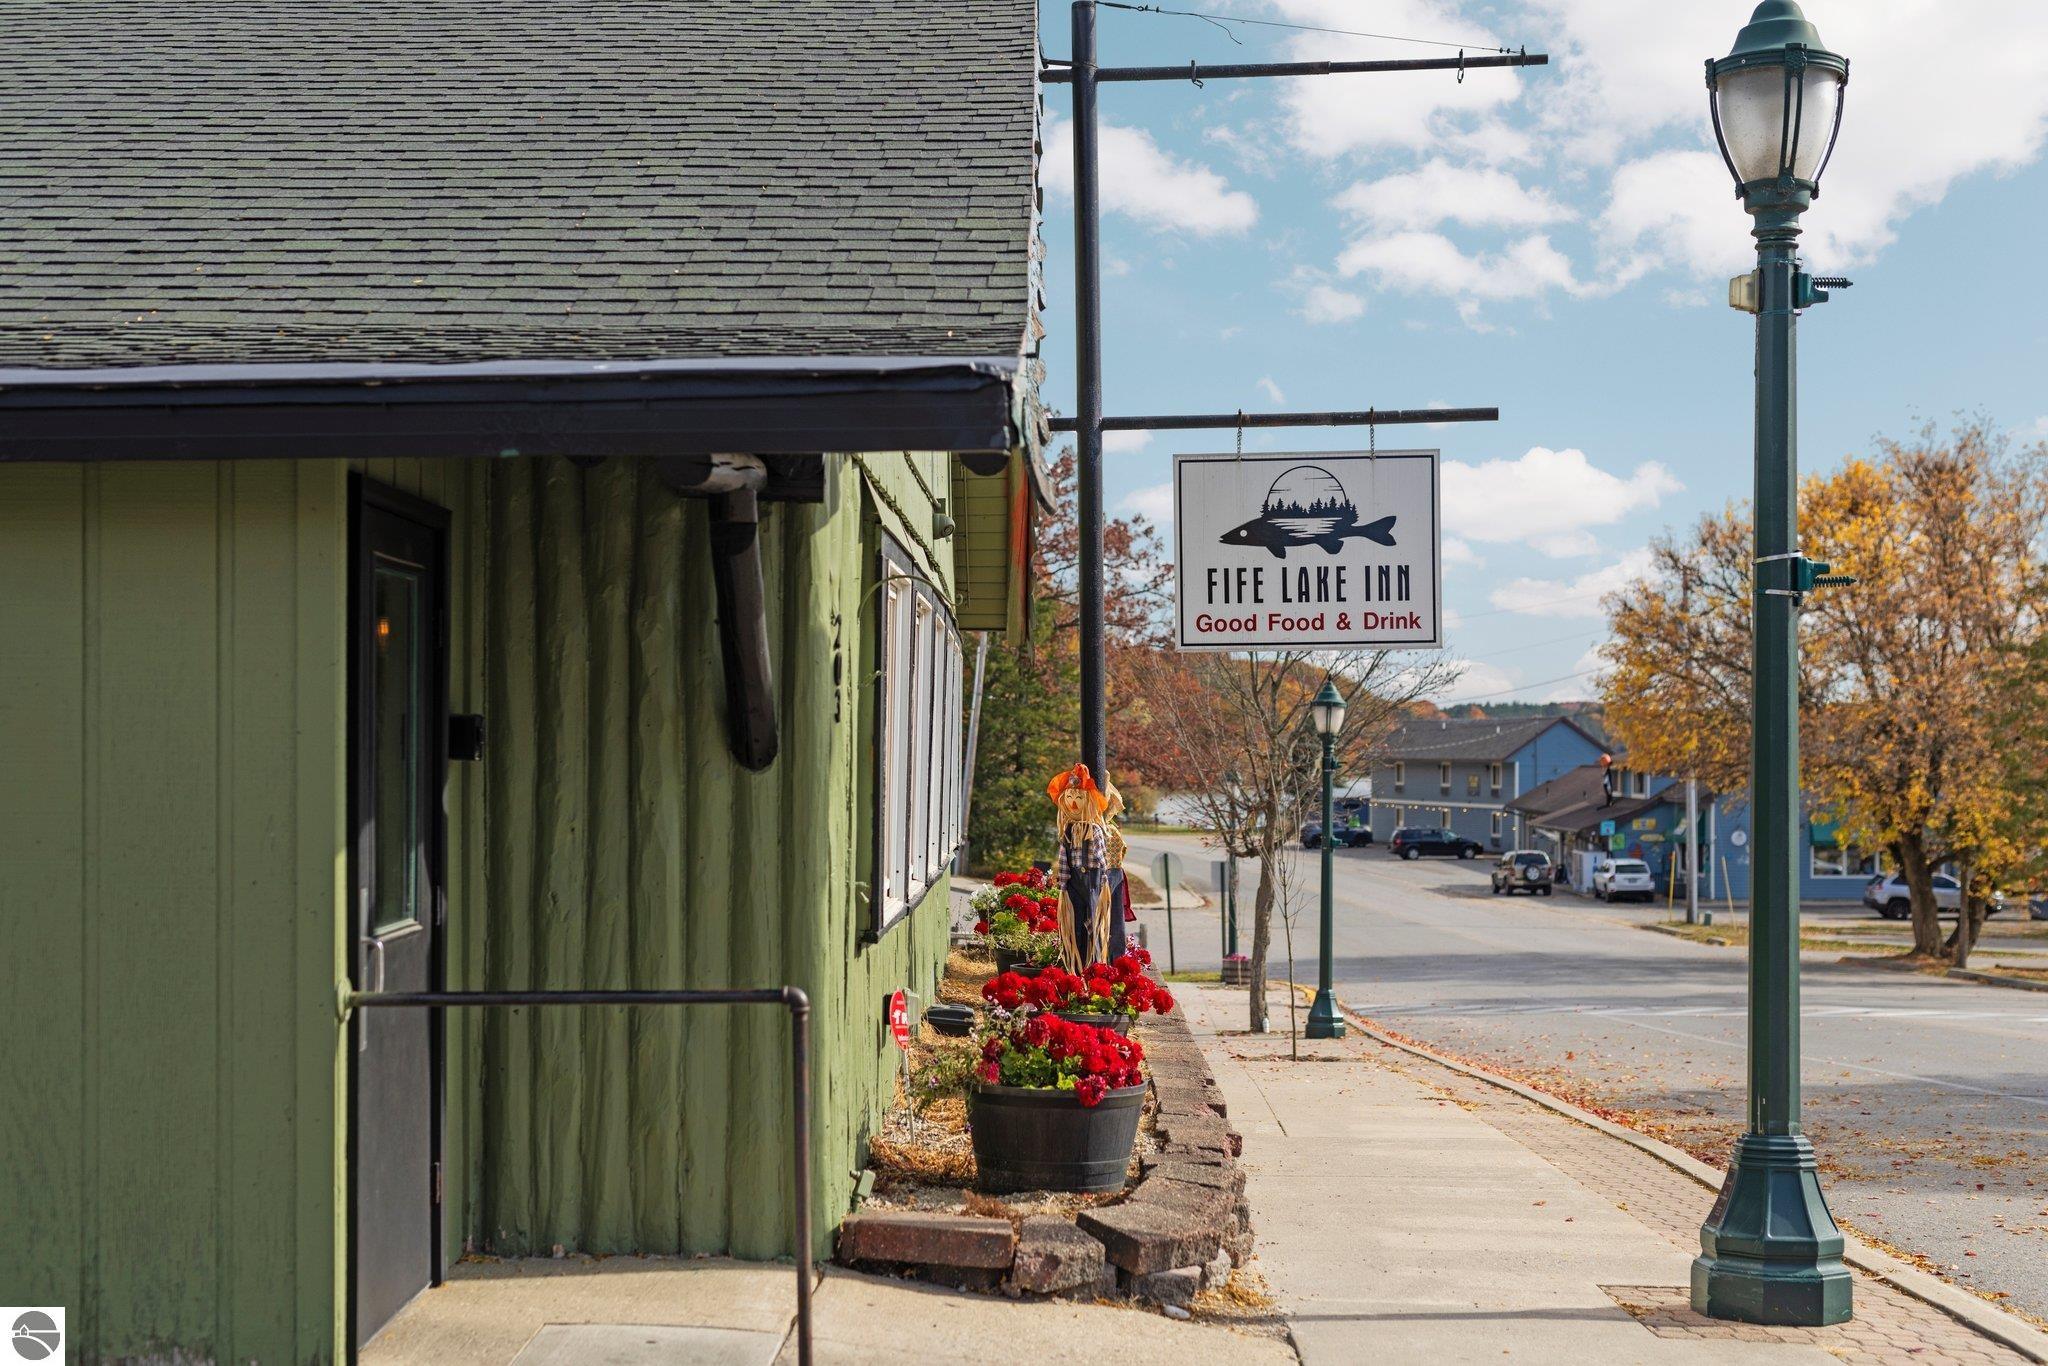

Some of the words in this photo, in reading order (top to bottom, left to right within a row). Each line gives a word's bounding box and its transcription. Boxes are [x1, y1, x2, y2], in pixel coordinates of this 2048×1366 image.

[1207, 567, 1264, 604] FIFE
[1281, 565, 1347, 602] LAKE
[1364, 564, 1410, 601] INN
[1195, 613, 1257, 632] Good
[1268, 613, 1325, 631] Food
[1336, 612, 1352, 631] &
[1363, 611, 1422, 630] Drink
